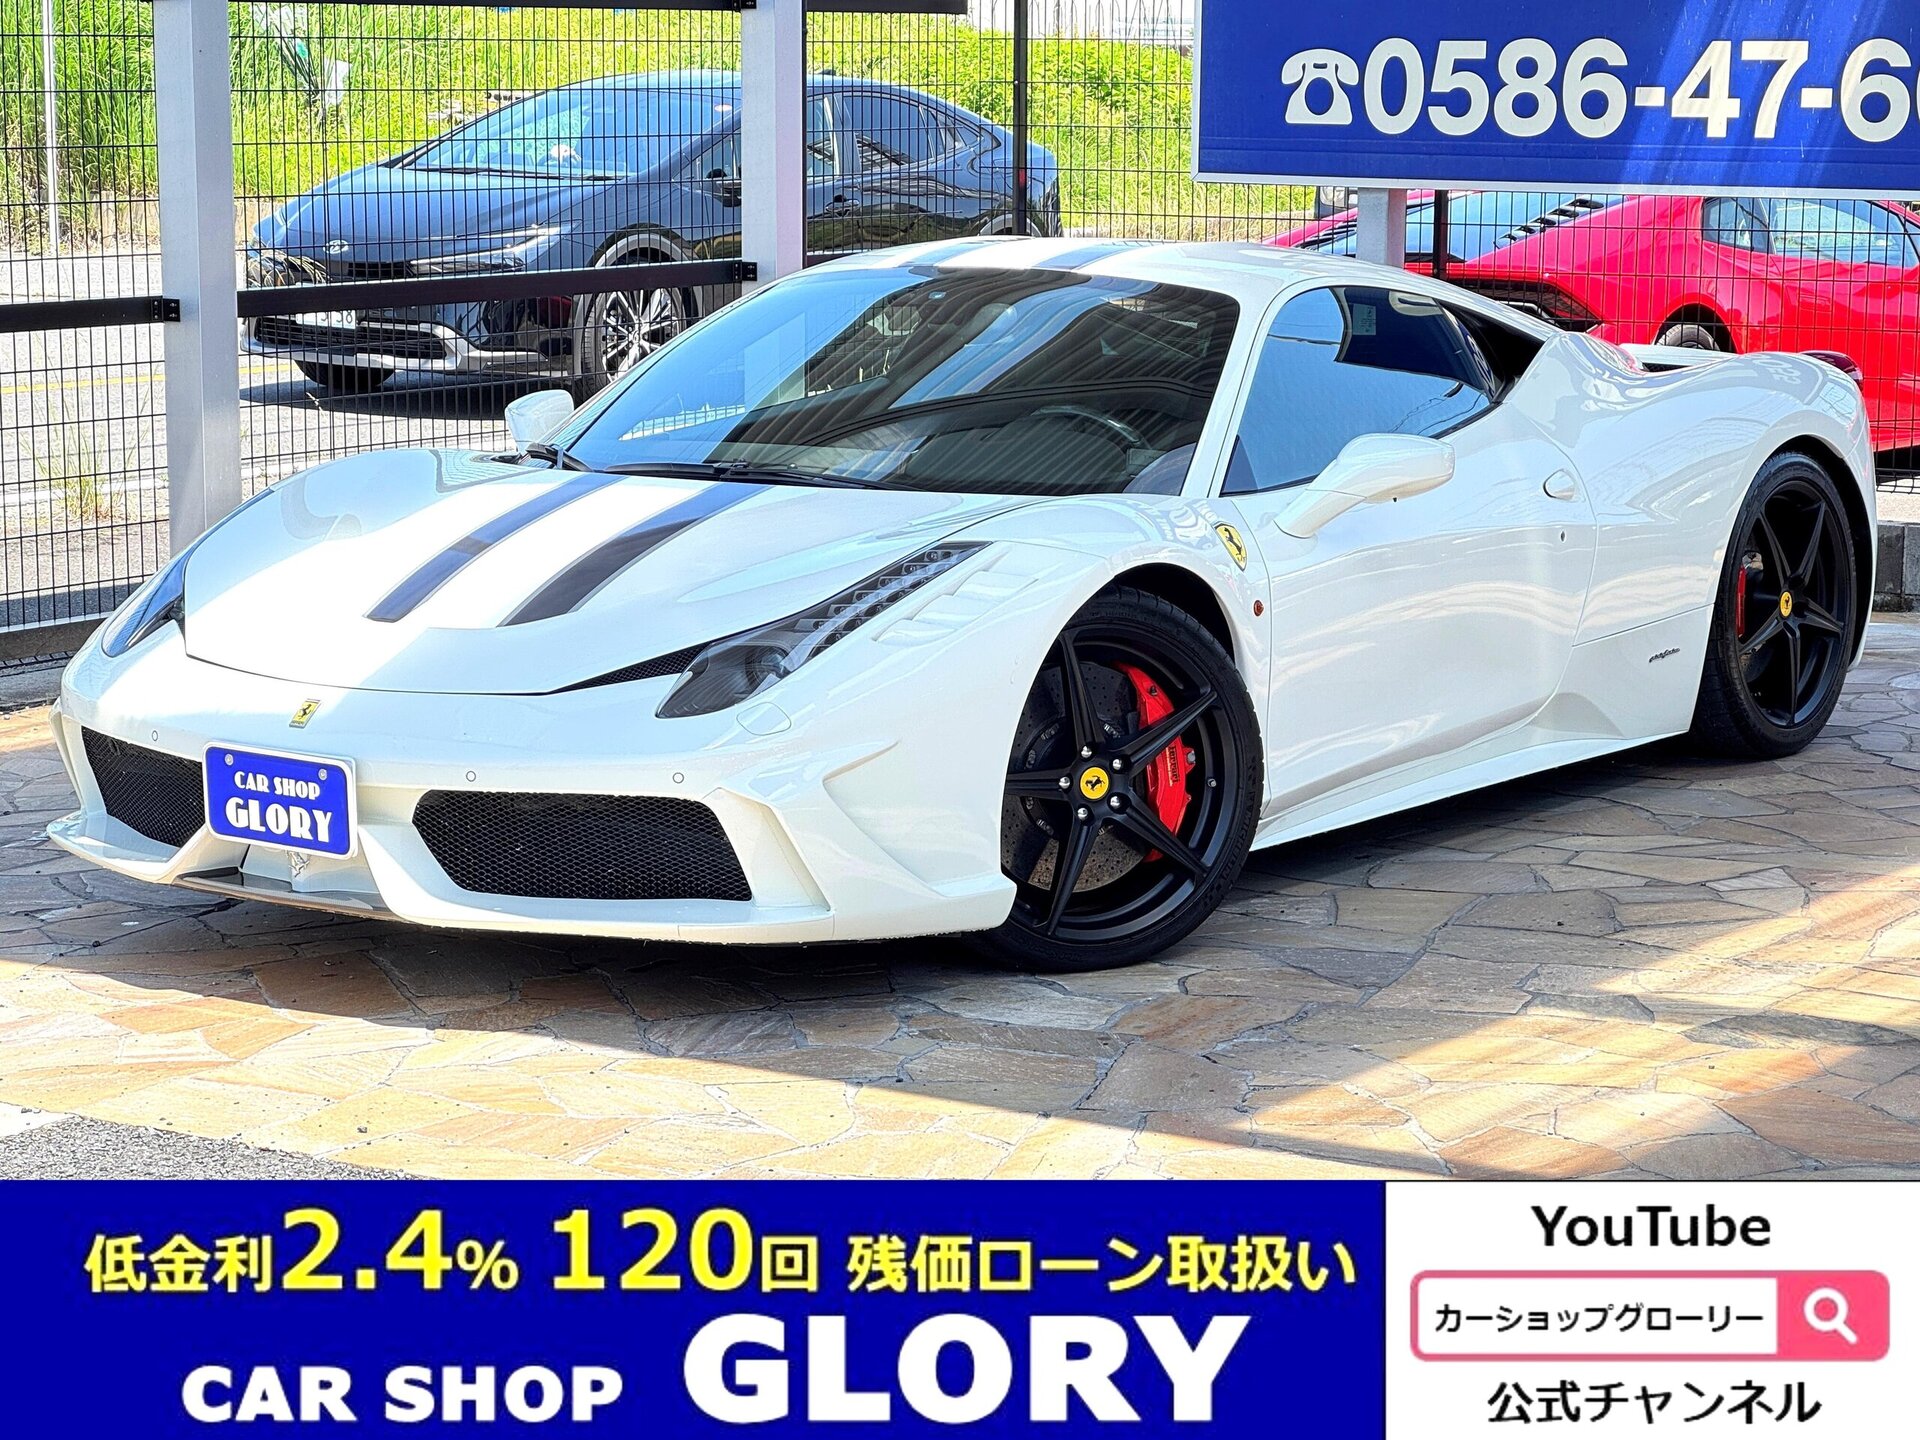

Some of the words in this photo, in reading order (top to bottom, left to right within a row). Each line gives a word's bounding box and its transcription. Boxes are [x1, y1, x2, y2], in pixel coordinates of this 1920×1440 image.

[1364, 37, 1920, 142] 0586-47-6
[234, 770, 270, 793] CAR
[273, 775, 321, 801] SHOP
[225, 796, 333, 844] GLORY
